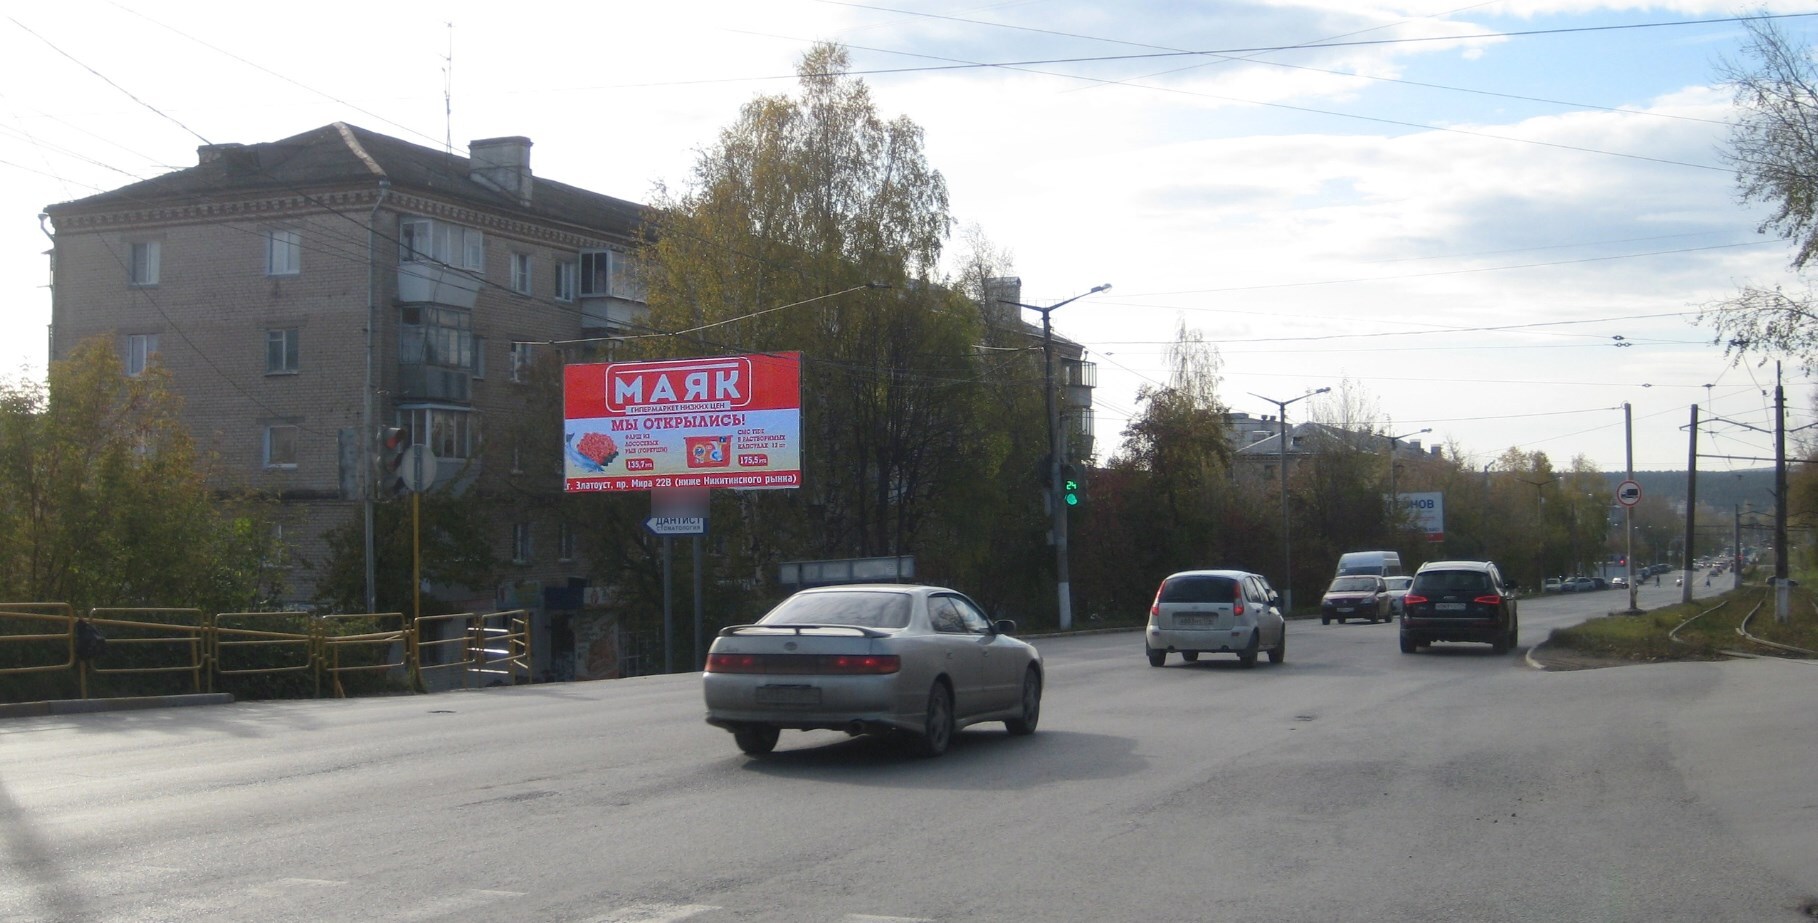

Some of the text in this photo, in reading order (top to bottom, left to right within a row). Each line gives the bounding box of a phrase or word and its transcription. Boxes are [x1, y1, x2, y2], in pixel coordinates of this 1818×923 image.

[615, 370, 741, 404] МАЯК
[630, 401, 725, 413] ГИПЕРМАРКЕТ НИЗКИХ ЦЕН
[611, 414, 745, 431] МЫ ОТКРЫЛИСЬ!
[616, 481, 629, 489] пр.
[631, 479, 653, 488] Мира
[656, 478, 672, 487] 22В
[674, 478, 701, 487] (ниже
[703, 475, 762, 485] Никитинского
[765, 474, 797, 484] рынка)
[1066, 480, 1077, 490] 24
